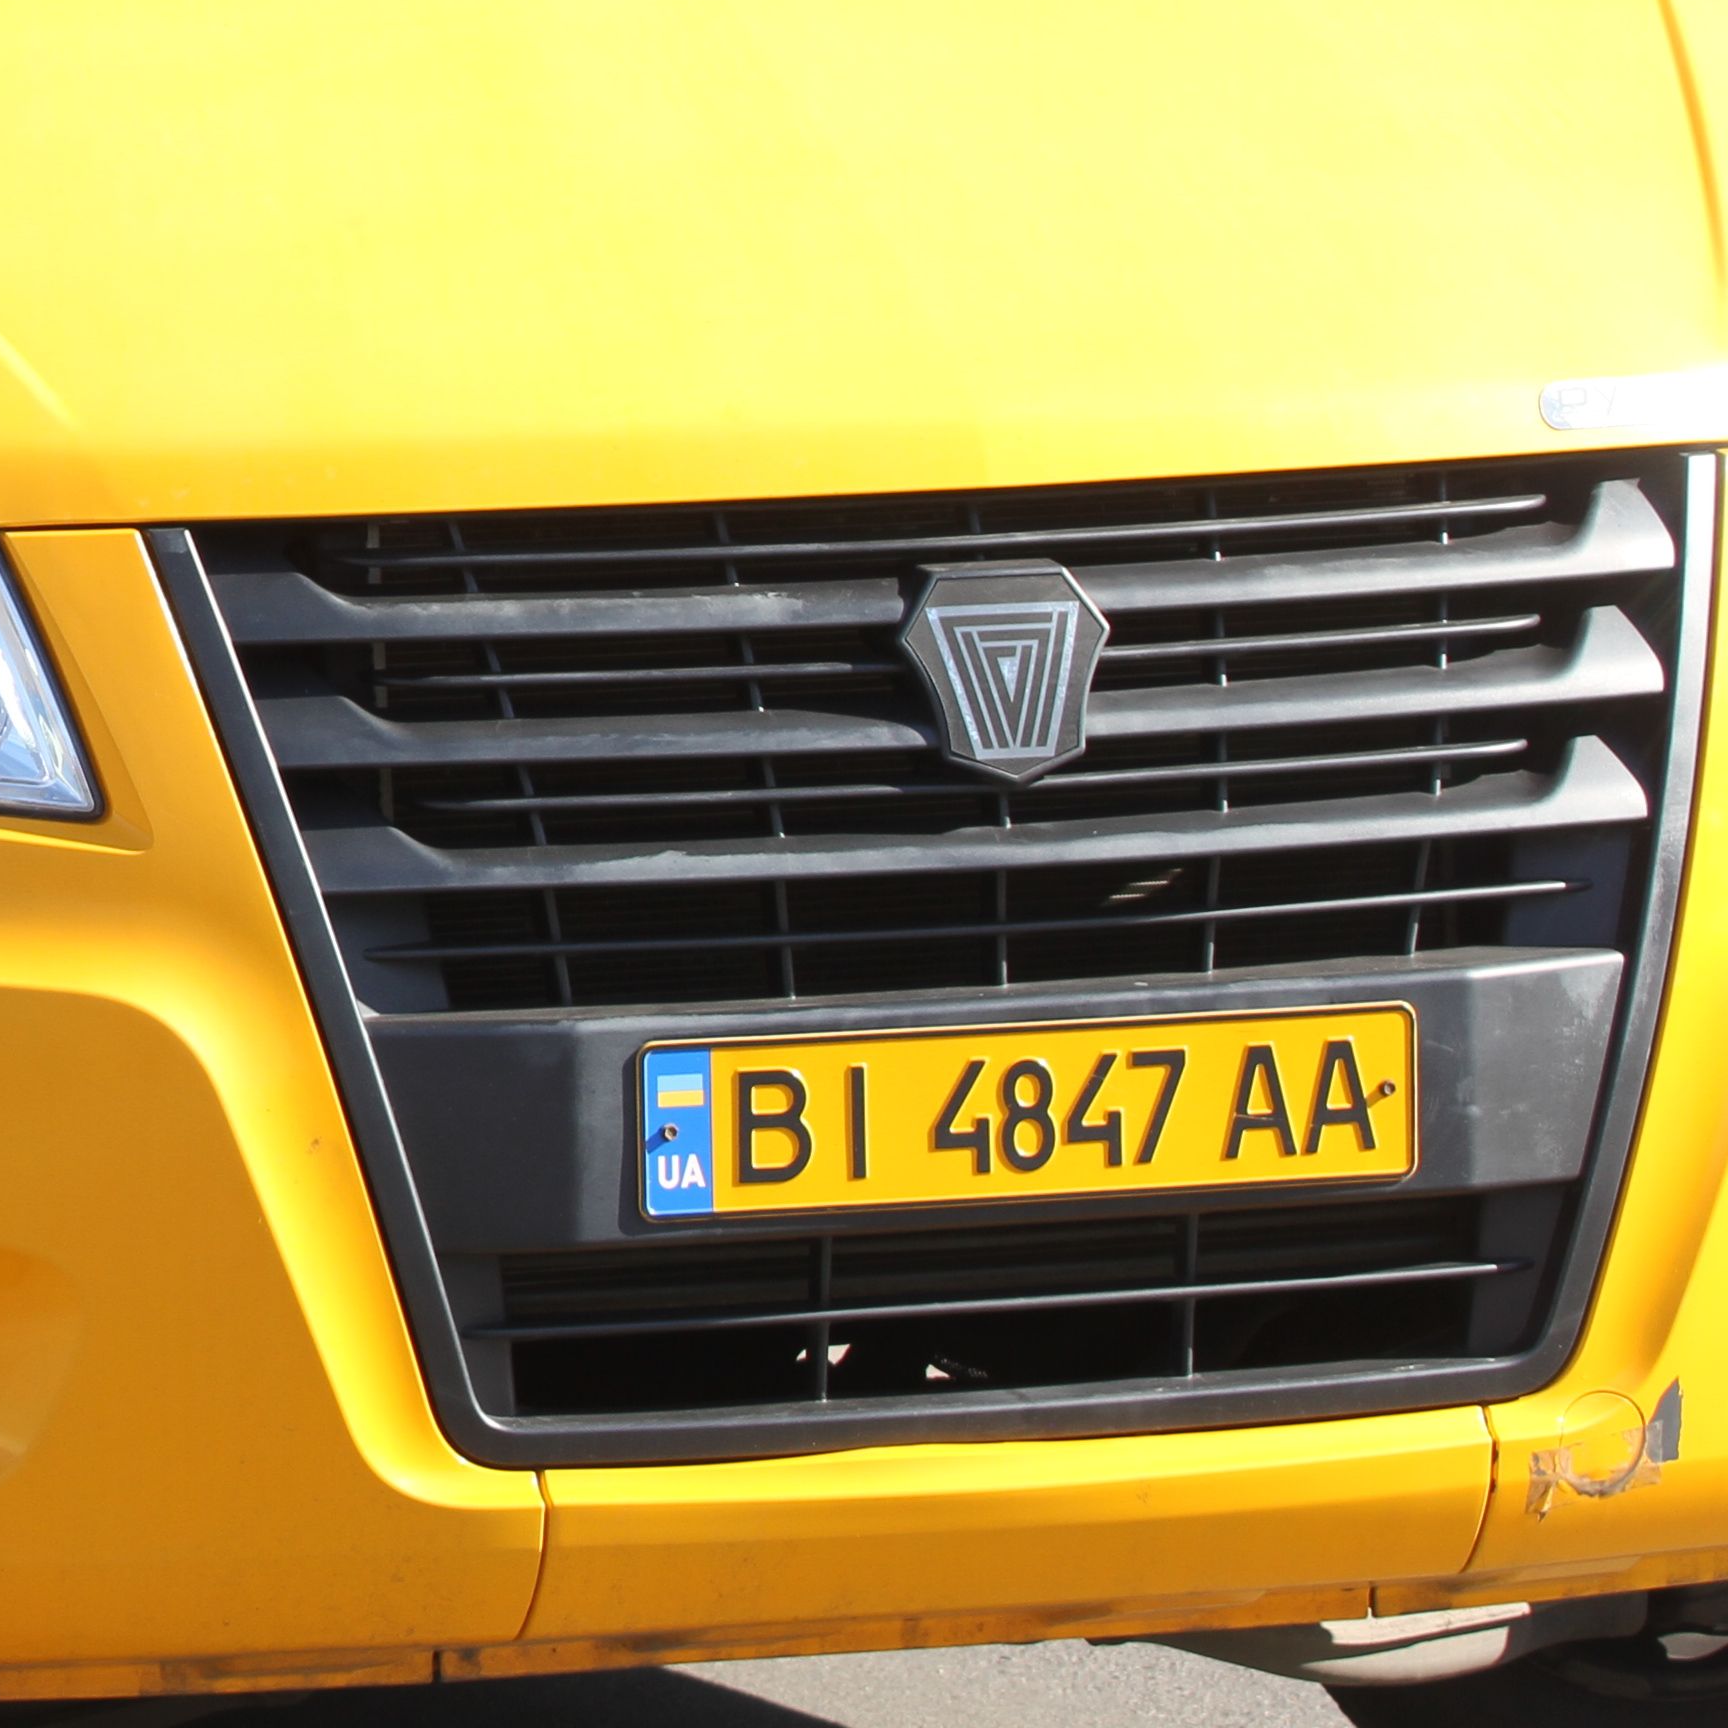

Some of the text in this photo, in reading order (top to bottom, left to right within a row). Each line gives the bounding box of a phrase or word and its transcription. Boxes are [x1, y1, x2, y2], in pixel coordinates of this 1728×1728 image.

[736, 1037, 1376, 1186] BI 4847 AA
[656, 1153, 707, 1190] UA
